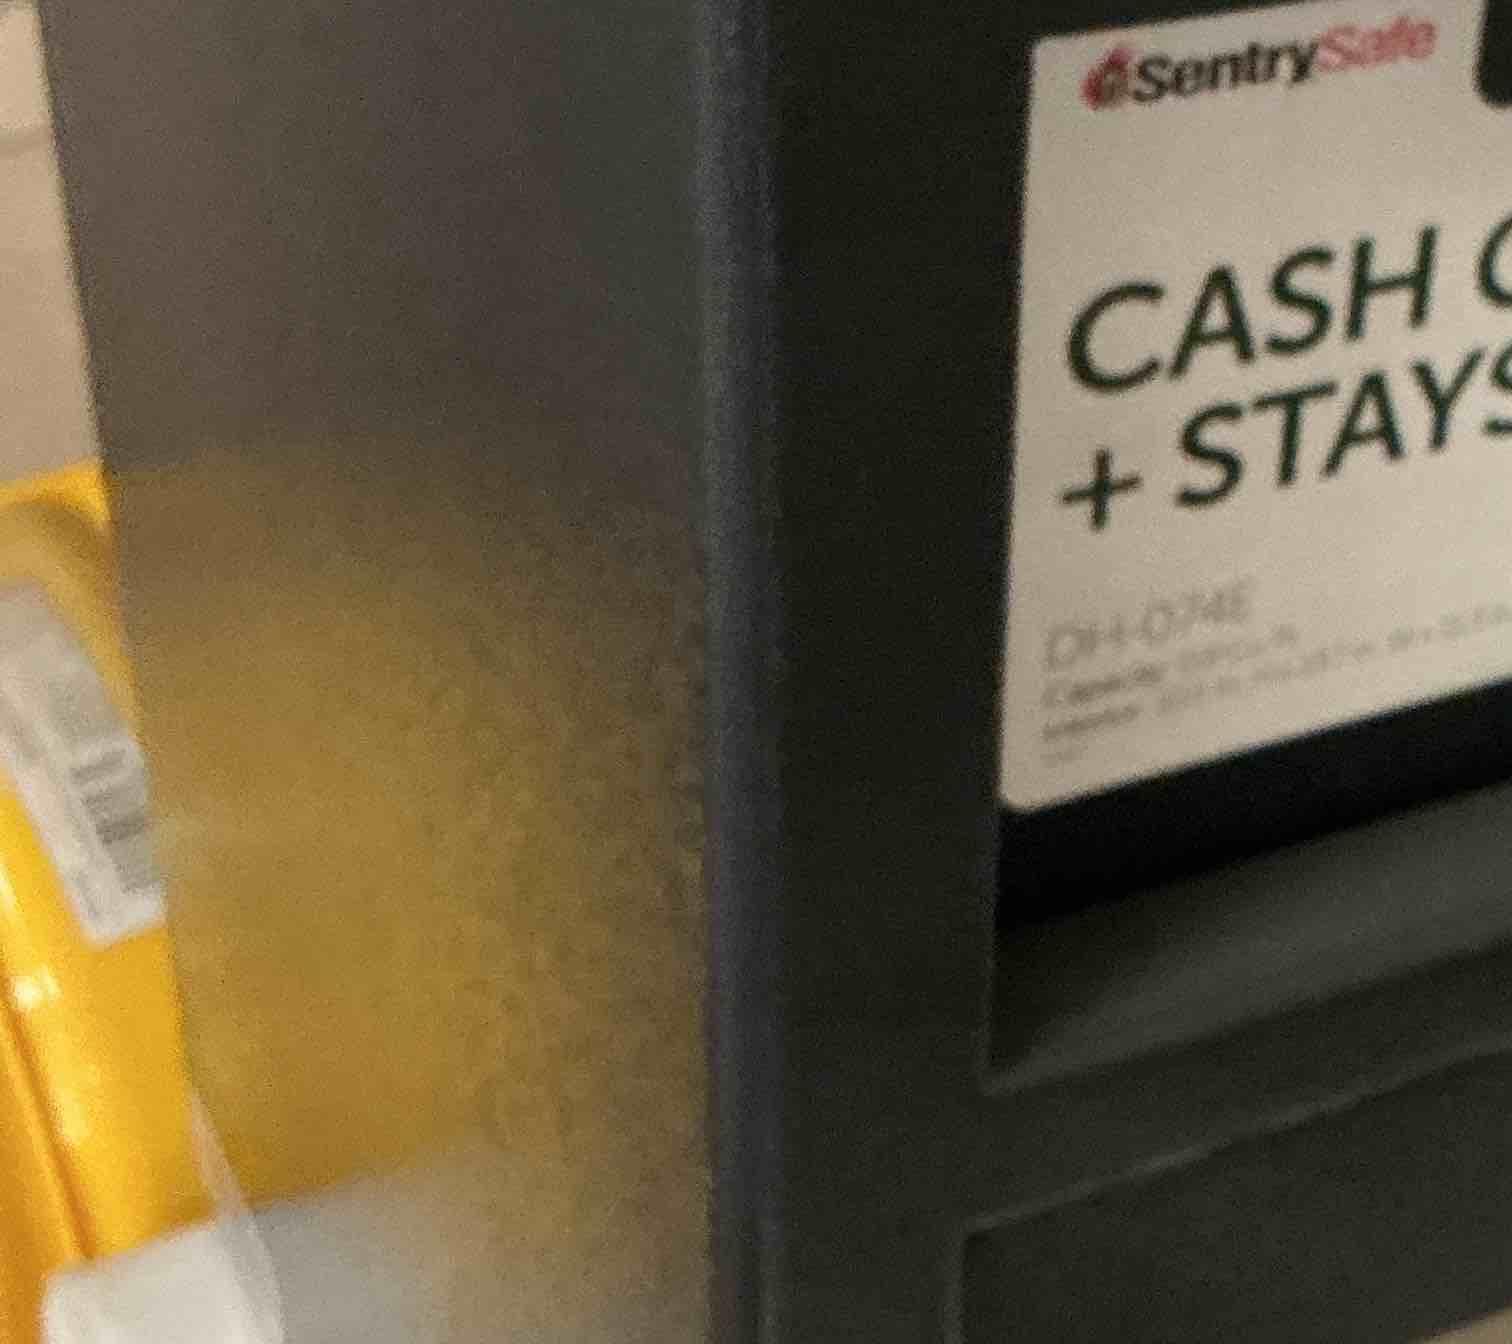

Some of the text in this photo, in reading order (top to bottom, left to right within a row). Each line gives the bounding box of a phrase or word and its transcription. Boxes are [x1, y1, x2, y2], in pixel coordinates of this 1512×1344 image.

[1129, 12, 1437, 104] SentrySafe
[1064, 224, 1440, 398] CASH
[1058, 447, 1143, 532] +
